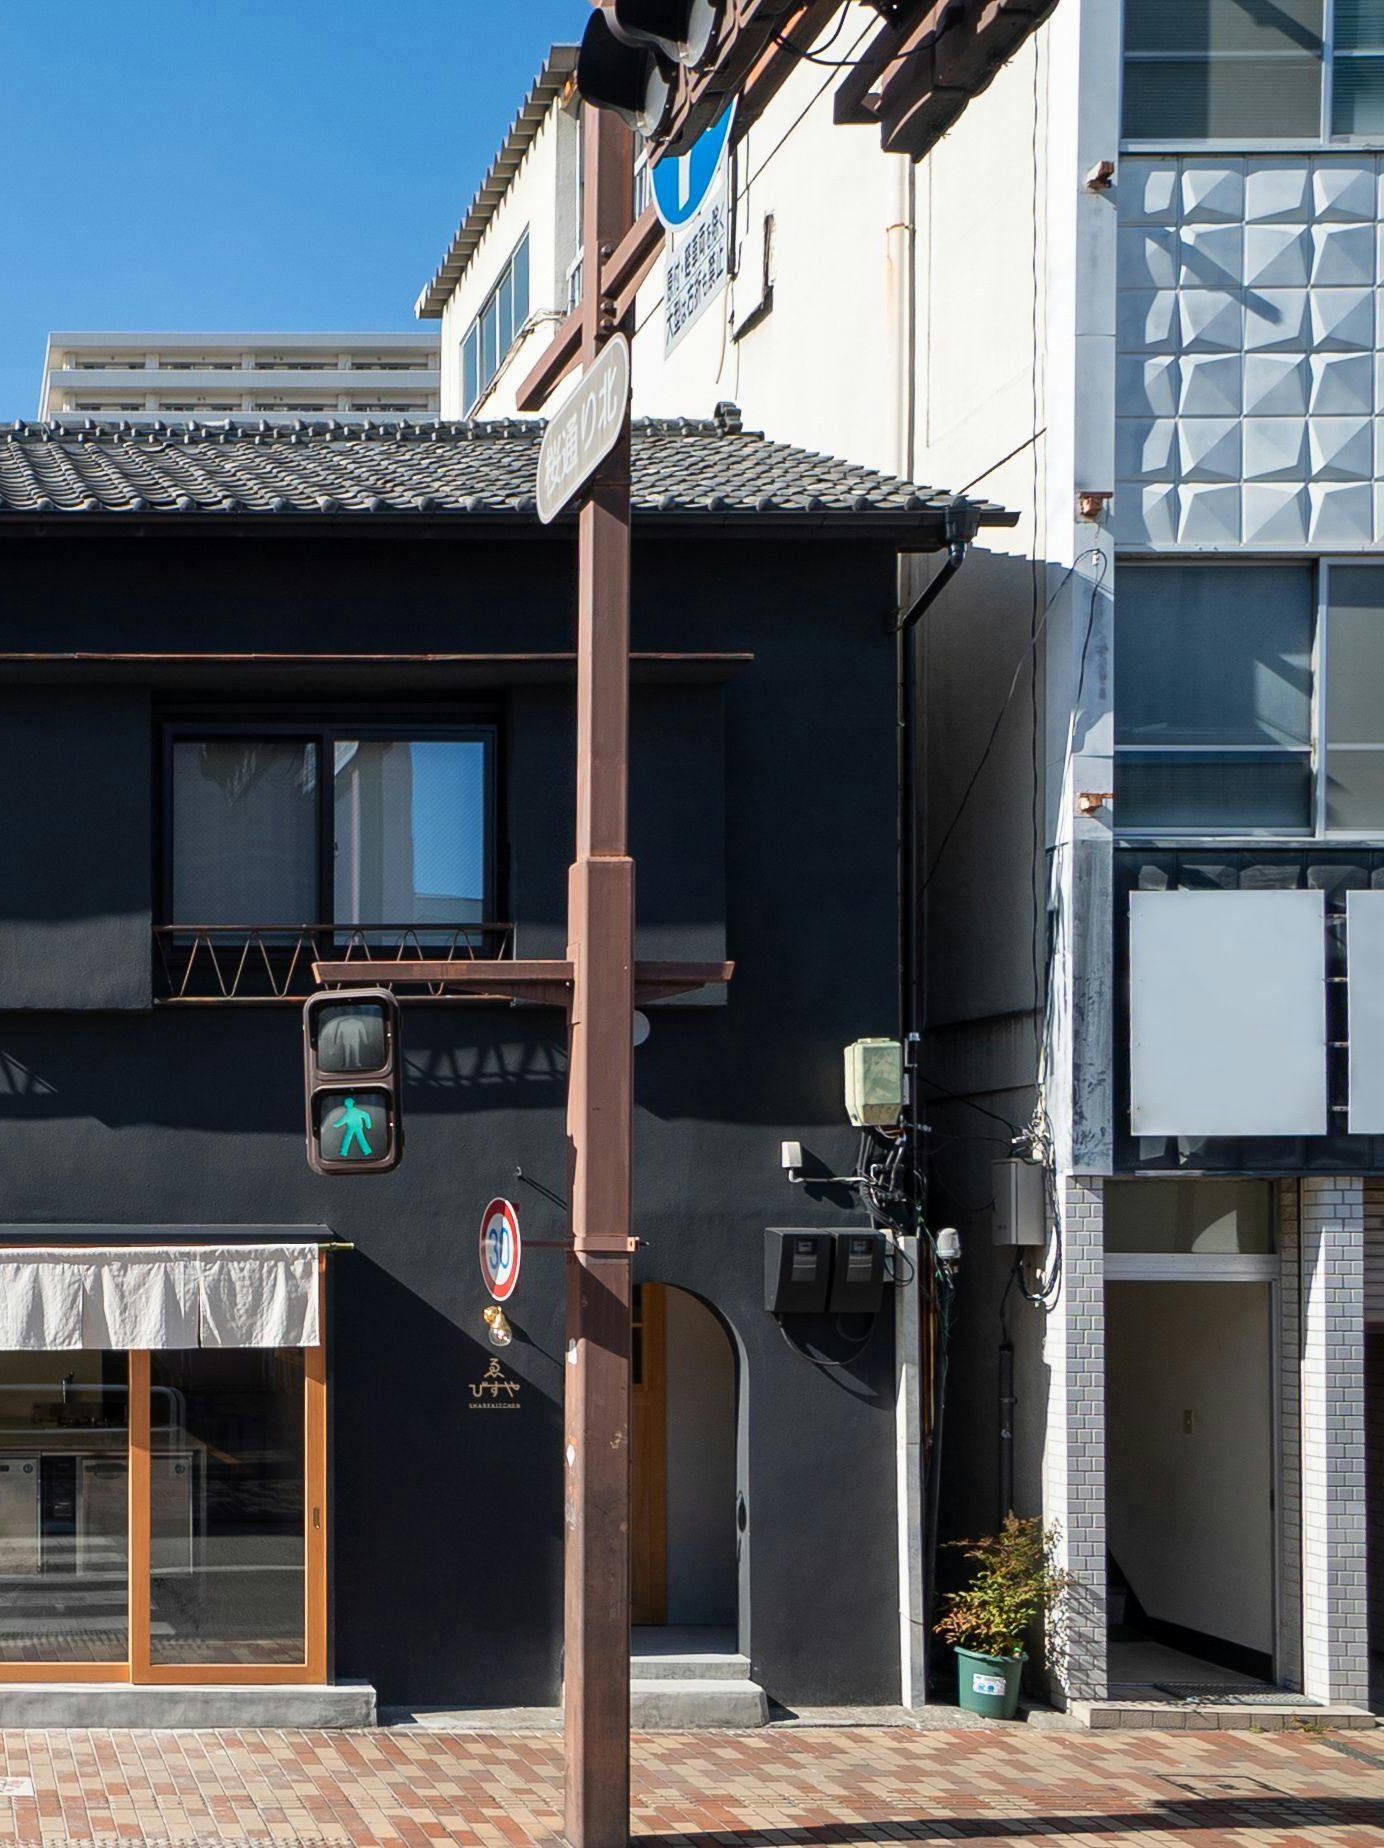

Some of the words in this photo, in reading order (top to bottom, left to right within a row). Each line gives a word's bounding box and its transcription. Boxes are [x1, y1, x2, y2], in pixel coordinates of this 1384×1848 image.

[543, 366, 619, 495] 桜通り北
[488, 1228, 511, 1270] 30
